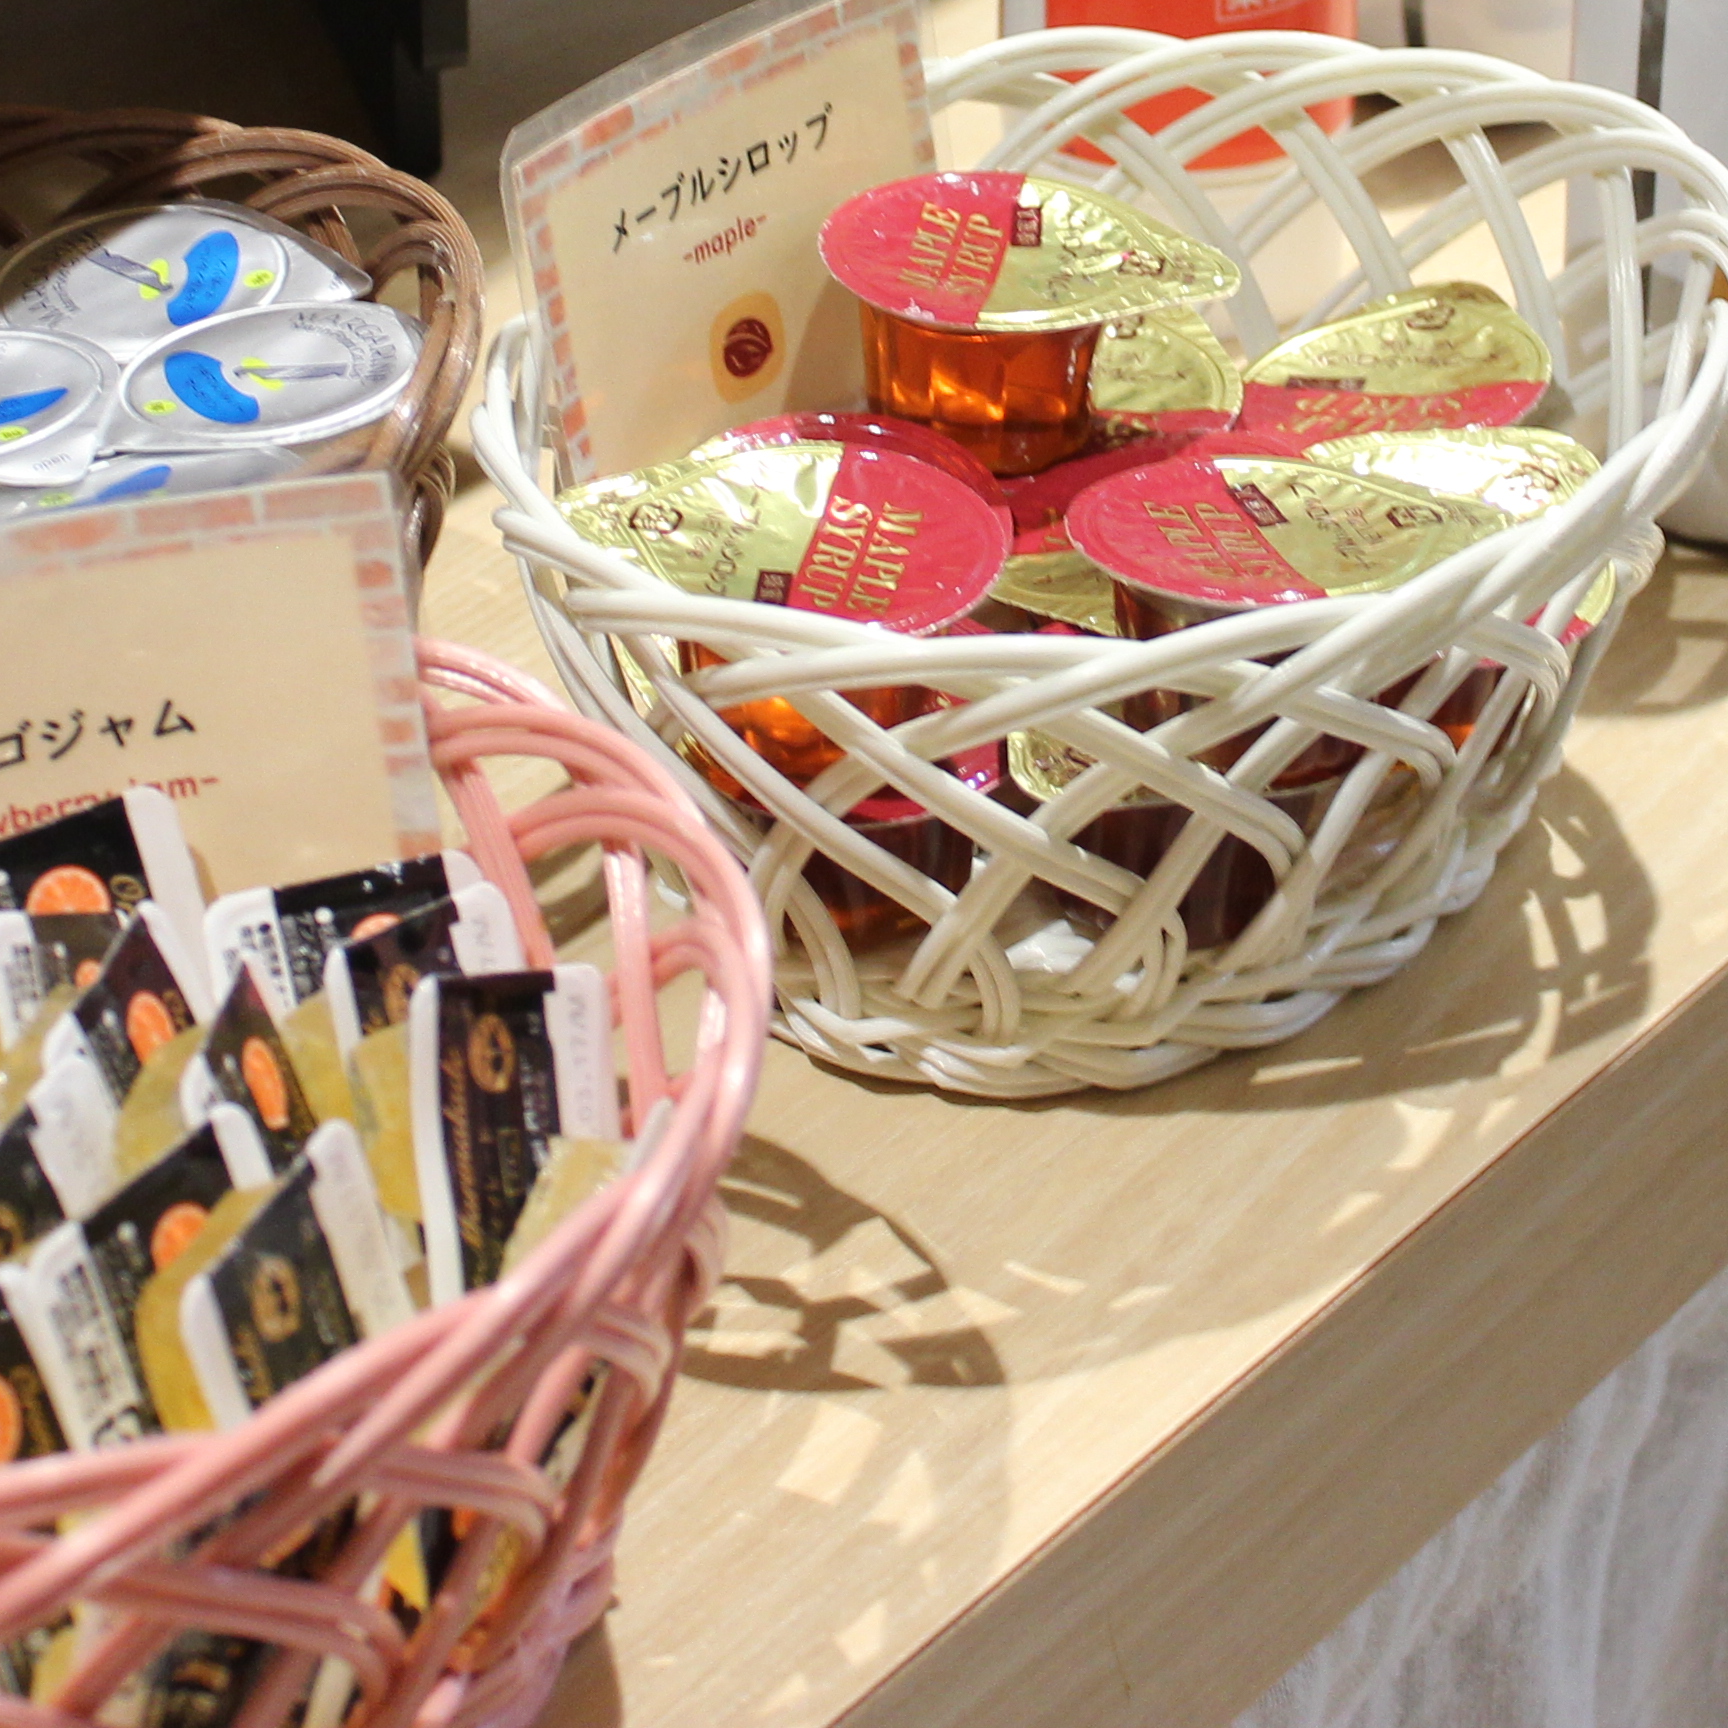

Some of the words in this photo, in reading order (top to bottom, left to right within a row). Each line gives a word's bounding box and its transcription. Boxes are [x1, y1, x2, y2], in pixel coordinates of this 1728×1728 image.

[613, 101, 833, 255] メープルシロップ
[798, 494, 876, 609] SYRUP
[845, 500, 927, 617] MAPLE
